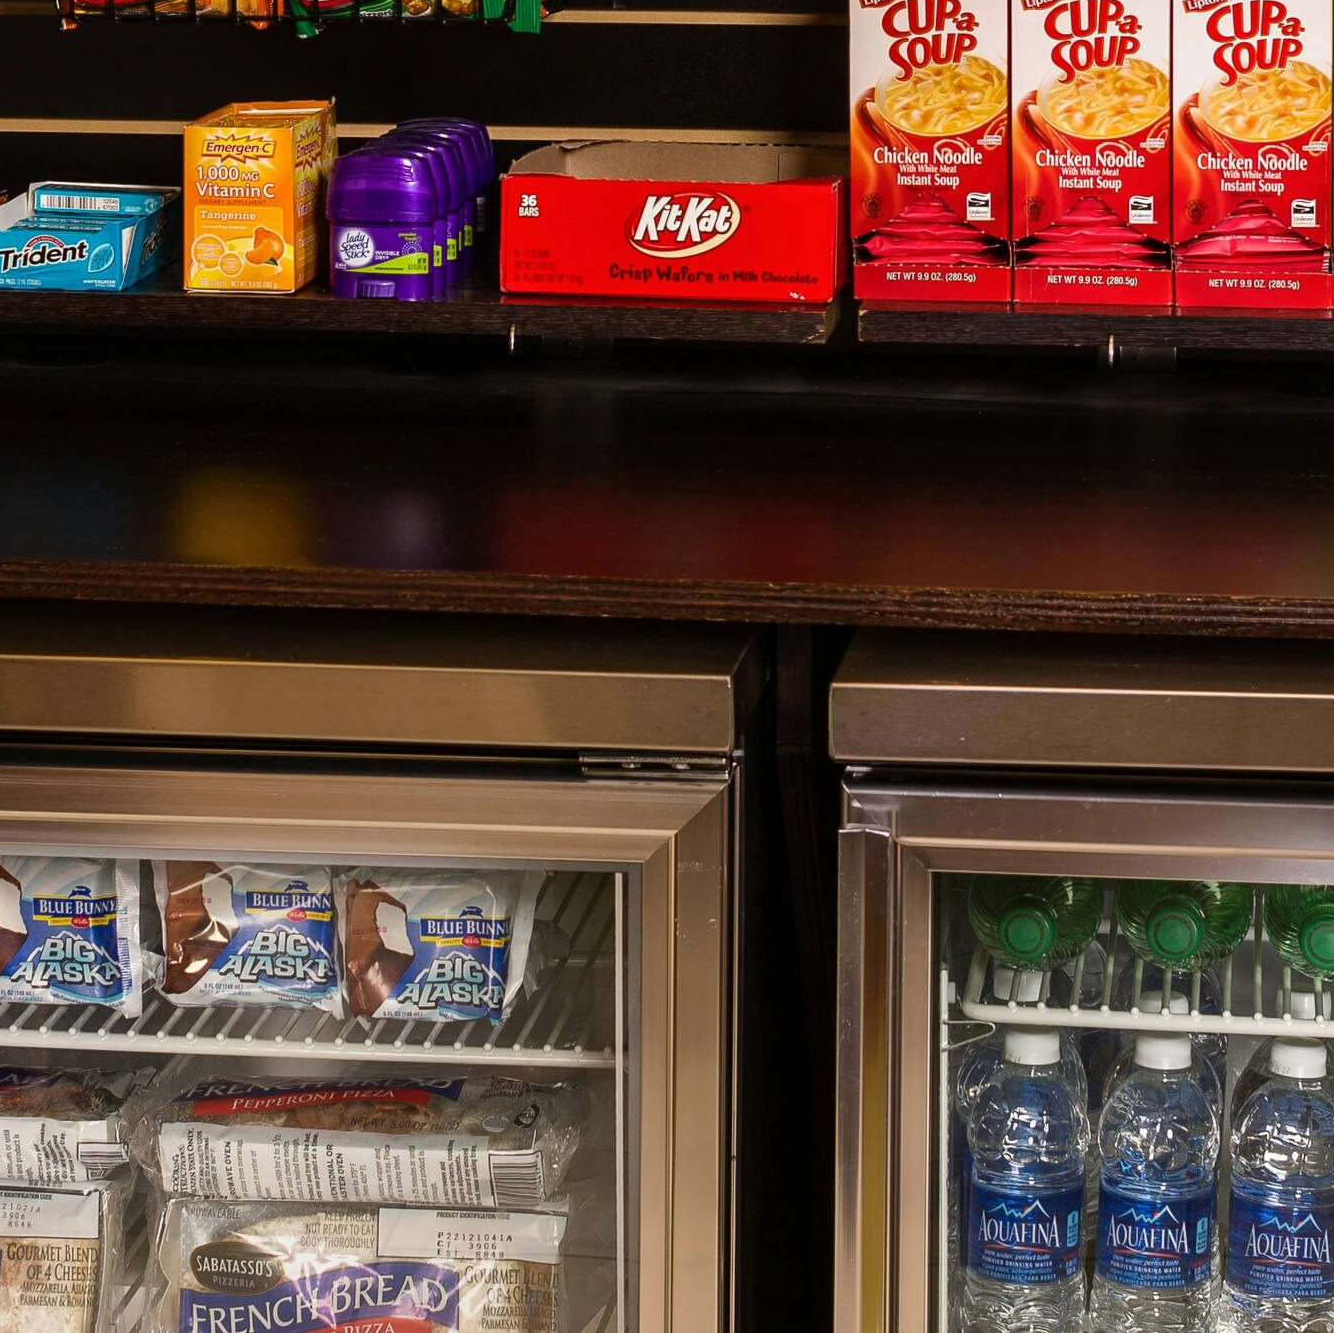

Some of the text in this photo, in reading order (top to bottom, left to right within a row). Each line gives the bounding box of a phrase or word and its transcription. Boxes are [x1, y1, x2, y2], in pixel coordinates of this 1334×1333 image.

[889, 33, 977, 81] SOUP
[1051, 36, 1140, 84] SOUP
[1213, 38, 1303, 87] SOUP
[874, 146, 982, 164] Chicken Noodle
[1036, 150, 1145, 167] Chicken Noodle
[1197, 153, 1307, 171] Chicken Noodle
[197, 166, 259, 181] 1,000 MG
[897, 174, 959, 189] Instant Soup
[196, 183, 275, 198] Vitamin C
[521, 195, 536, 206] 36
[200, 211, 256, 220] Tangerine
[519, 207, 539, 217] BARS
[341, 242, 369, 253] Speed
[345, 251, 370, 261] Stick
[609, 263, 817, 284] Crisp Wafers in Milk Chocolate
[887, 272, 901, 280] NET
[945, 273, 976, 282] (280.5g)
[40, 899, 116, 915] BLUE BUNNY
[42, 939, 95, 962] BIG
[13, 958, 120, 988] ALASKA
[979, 1209, 1060, 1247] AQUAFINA
[1106, 1218, 1190, 1253] AQUAFINA
[7, 1243, 98, 1262] GOURMET BLEND
[1244, 1224, 1330, 1264] AQUAFINA
[27, 1267, 42, 1280] OF
[45, 1264, 51, 1280] 4
[197, 1255, 272, 1277] SABATASSO'S
[213, 1277, 255, 1287] PIZZERIA
[332, 1275, 448, 1314] BREAD
